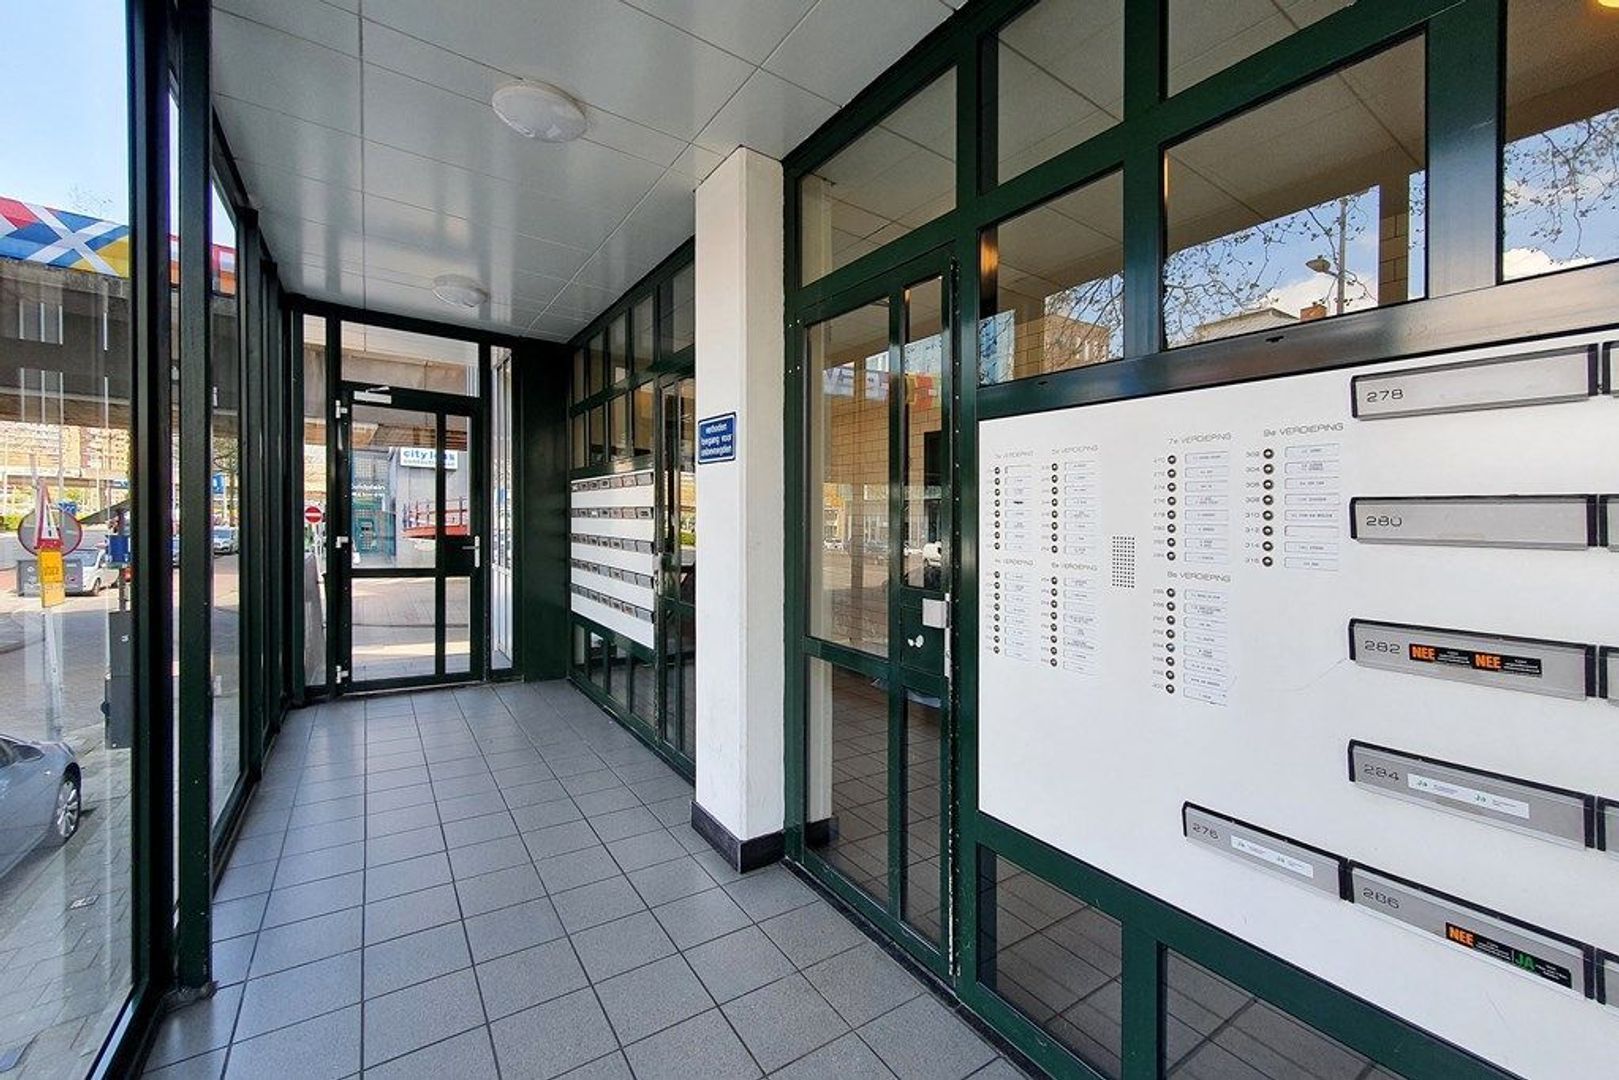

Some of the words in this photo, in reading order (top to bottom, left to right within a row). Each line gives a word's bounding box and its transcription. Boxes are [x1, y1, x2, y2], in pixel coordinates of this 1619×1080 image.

[1366, 388, 1404, 403] 278
[1279, 422, 1344, 436] VERDIEPING
[403, 449, 427, 461] city
[1366, 515, 1403, 527] 280
[1179, 571, 1232, 583] VERDIEPING
[1364, 640, 1401, 654] 282
[1411, 646, 1436, 661] NEE
[1475, 654, 1502, 669] NEE
[1363, 763, 1400, 781] 284
[1362, 887, 1401, 909] 286
[1448, 925, 1475, 947] NEE
[1515, 952, 1535, 970] JA
